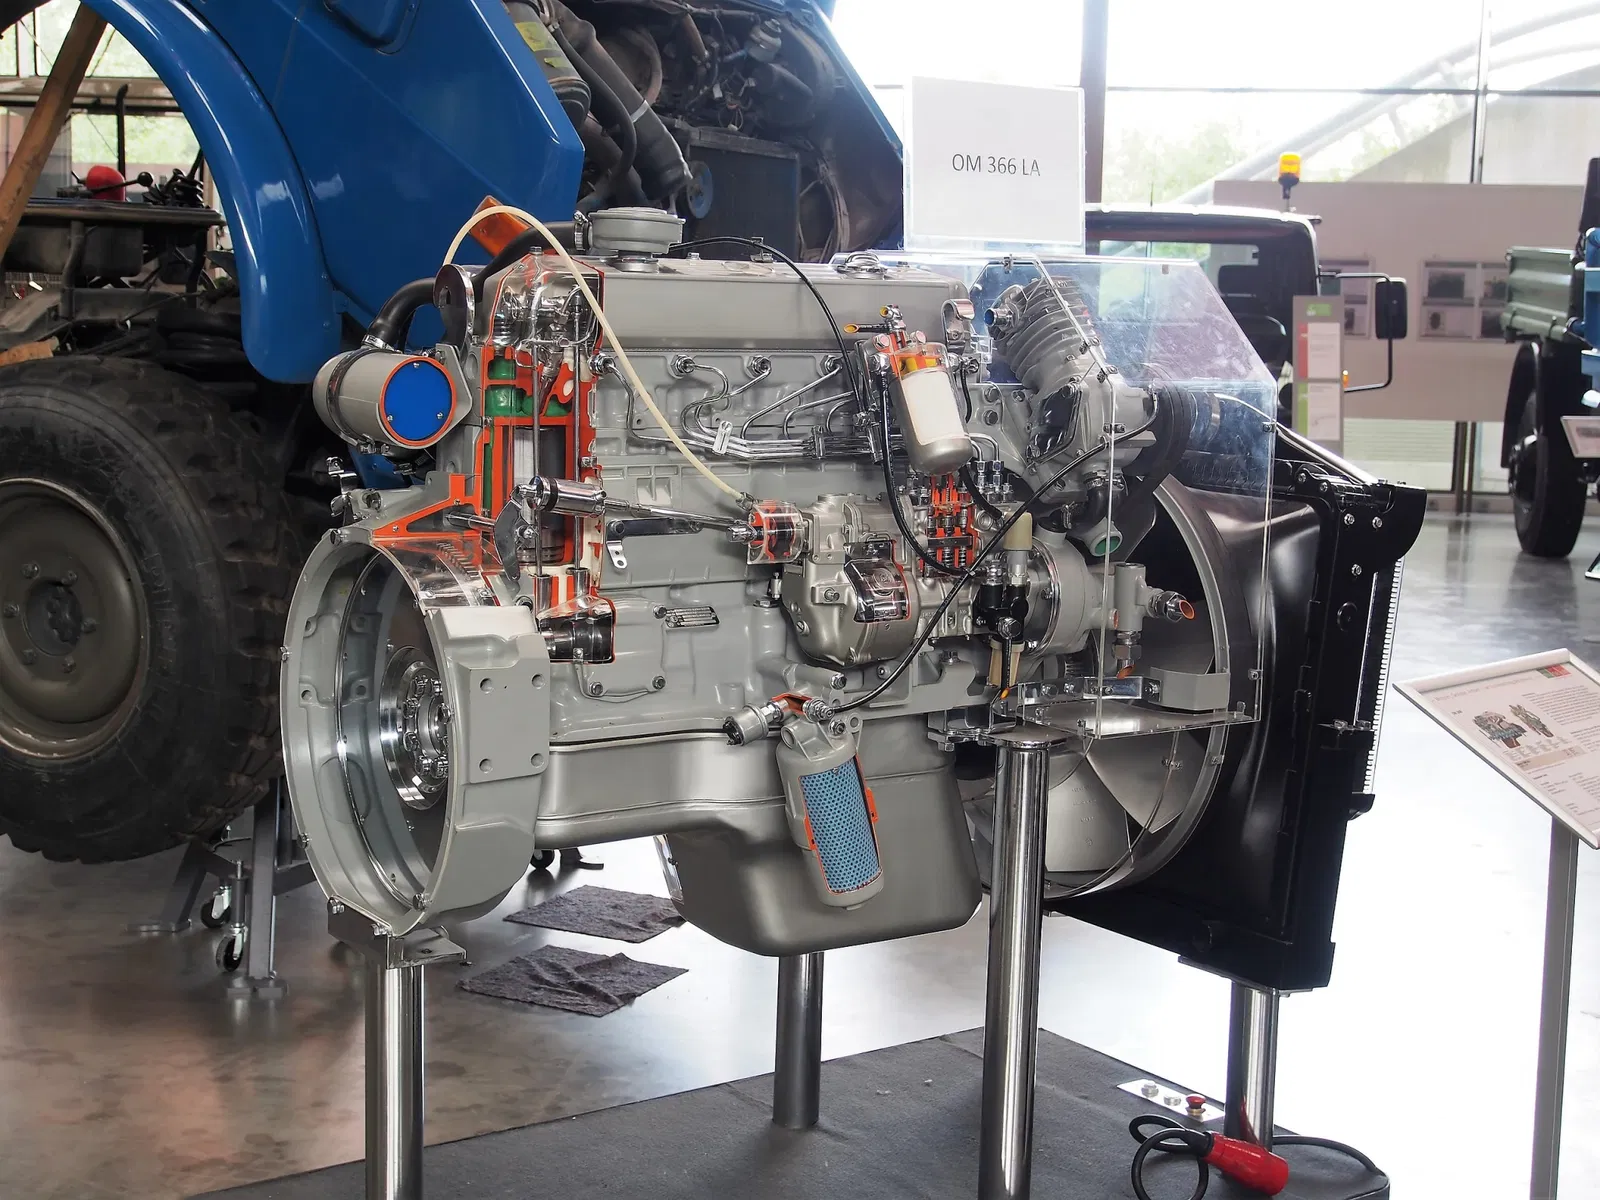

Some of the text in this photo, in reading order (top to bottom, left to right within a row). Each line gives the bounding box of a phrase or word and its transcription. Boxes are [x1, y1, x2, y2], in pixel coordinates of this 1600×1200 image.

[952, 153, 1040, 176] OM 366 LA
